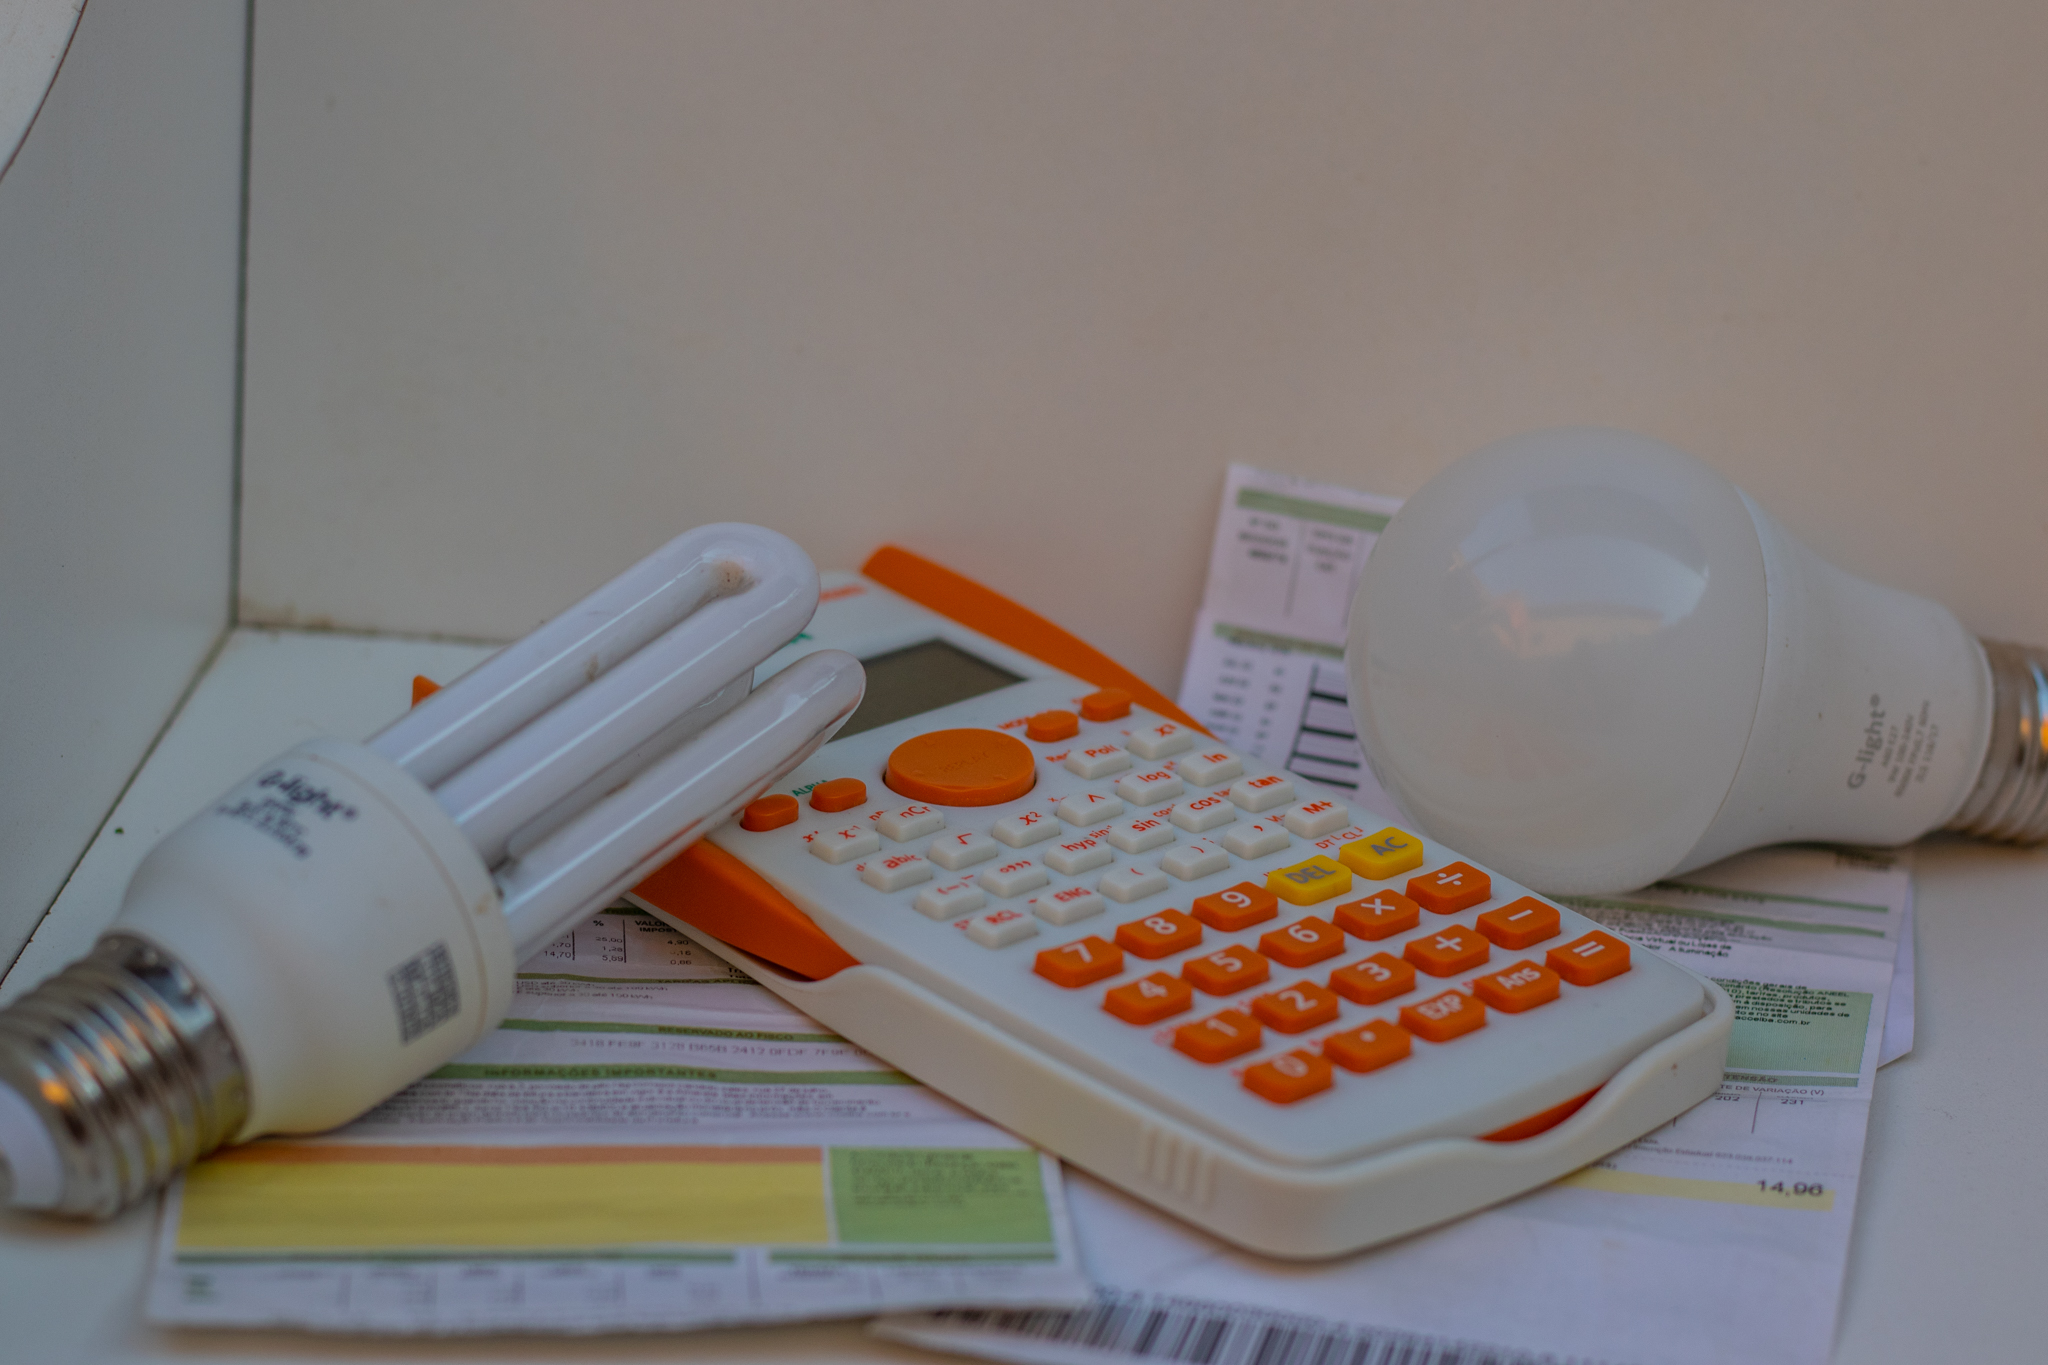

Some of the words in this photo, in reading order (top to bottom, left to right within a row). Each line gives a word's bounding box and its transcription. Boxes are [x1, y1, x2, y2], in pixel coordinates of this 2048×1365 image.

[1137, 770, 1172, 783] log
[1248, 775, 1284, 788] tan
[900, 805, 931, 820] nCr
[1190, 796, 1222, 811] cos
[1302, 801, 1334, 815] M+
[1131, 818, 1161, 832] sin
[1061, 838, 1097, 852] hyp
[1370, 836, 1409, 857] AC
[1284, 864, 1337, 885] DEL
[1220, 891, 1252, 909] 9
[1143, 917, 1178, 936] 8
[1287, 924, 1320, 944] 6
[543, 950, 572, 960] 14,70
[1061, 942, 1093, 964] 7
[1208, 951, 1244, 974] 5
[1356, 961, 1392, 982] 3
[1495, 967, 1542, 991] Ans
[1137, 979, 1169, 998] 4
[1278, 989, 1319, 1012] 2
[1205, 1017, 1240, 1038] 1
[605, 1066, 717, 1080] IMPORTANTES
[1270, 1053, 1310, 1078] 0
[1752, 1086, 1808, 1096] VARIAÇÃO
[1809, 1088, 1825, 1097] (V)
[1780, 1098, 1805, 1106] 231
[1756, 1179, 1824, 1198] 14,96
